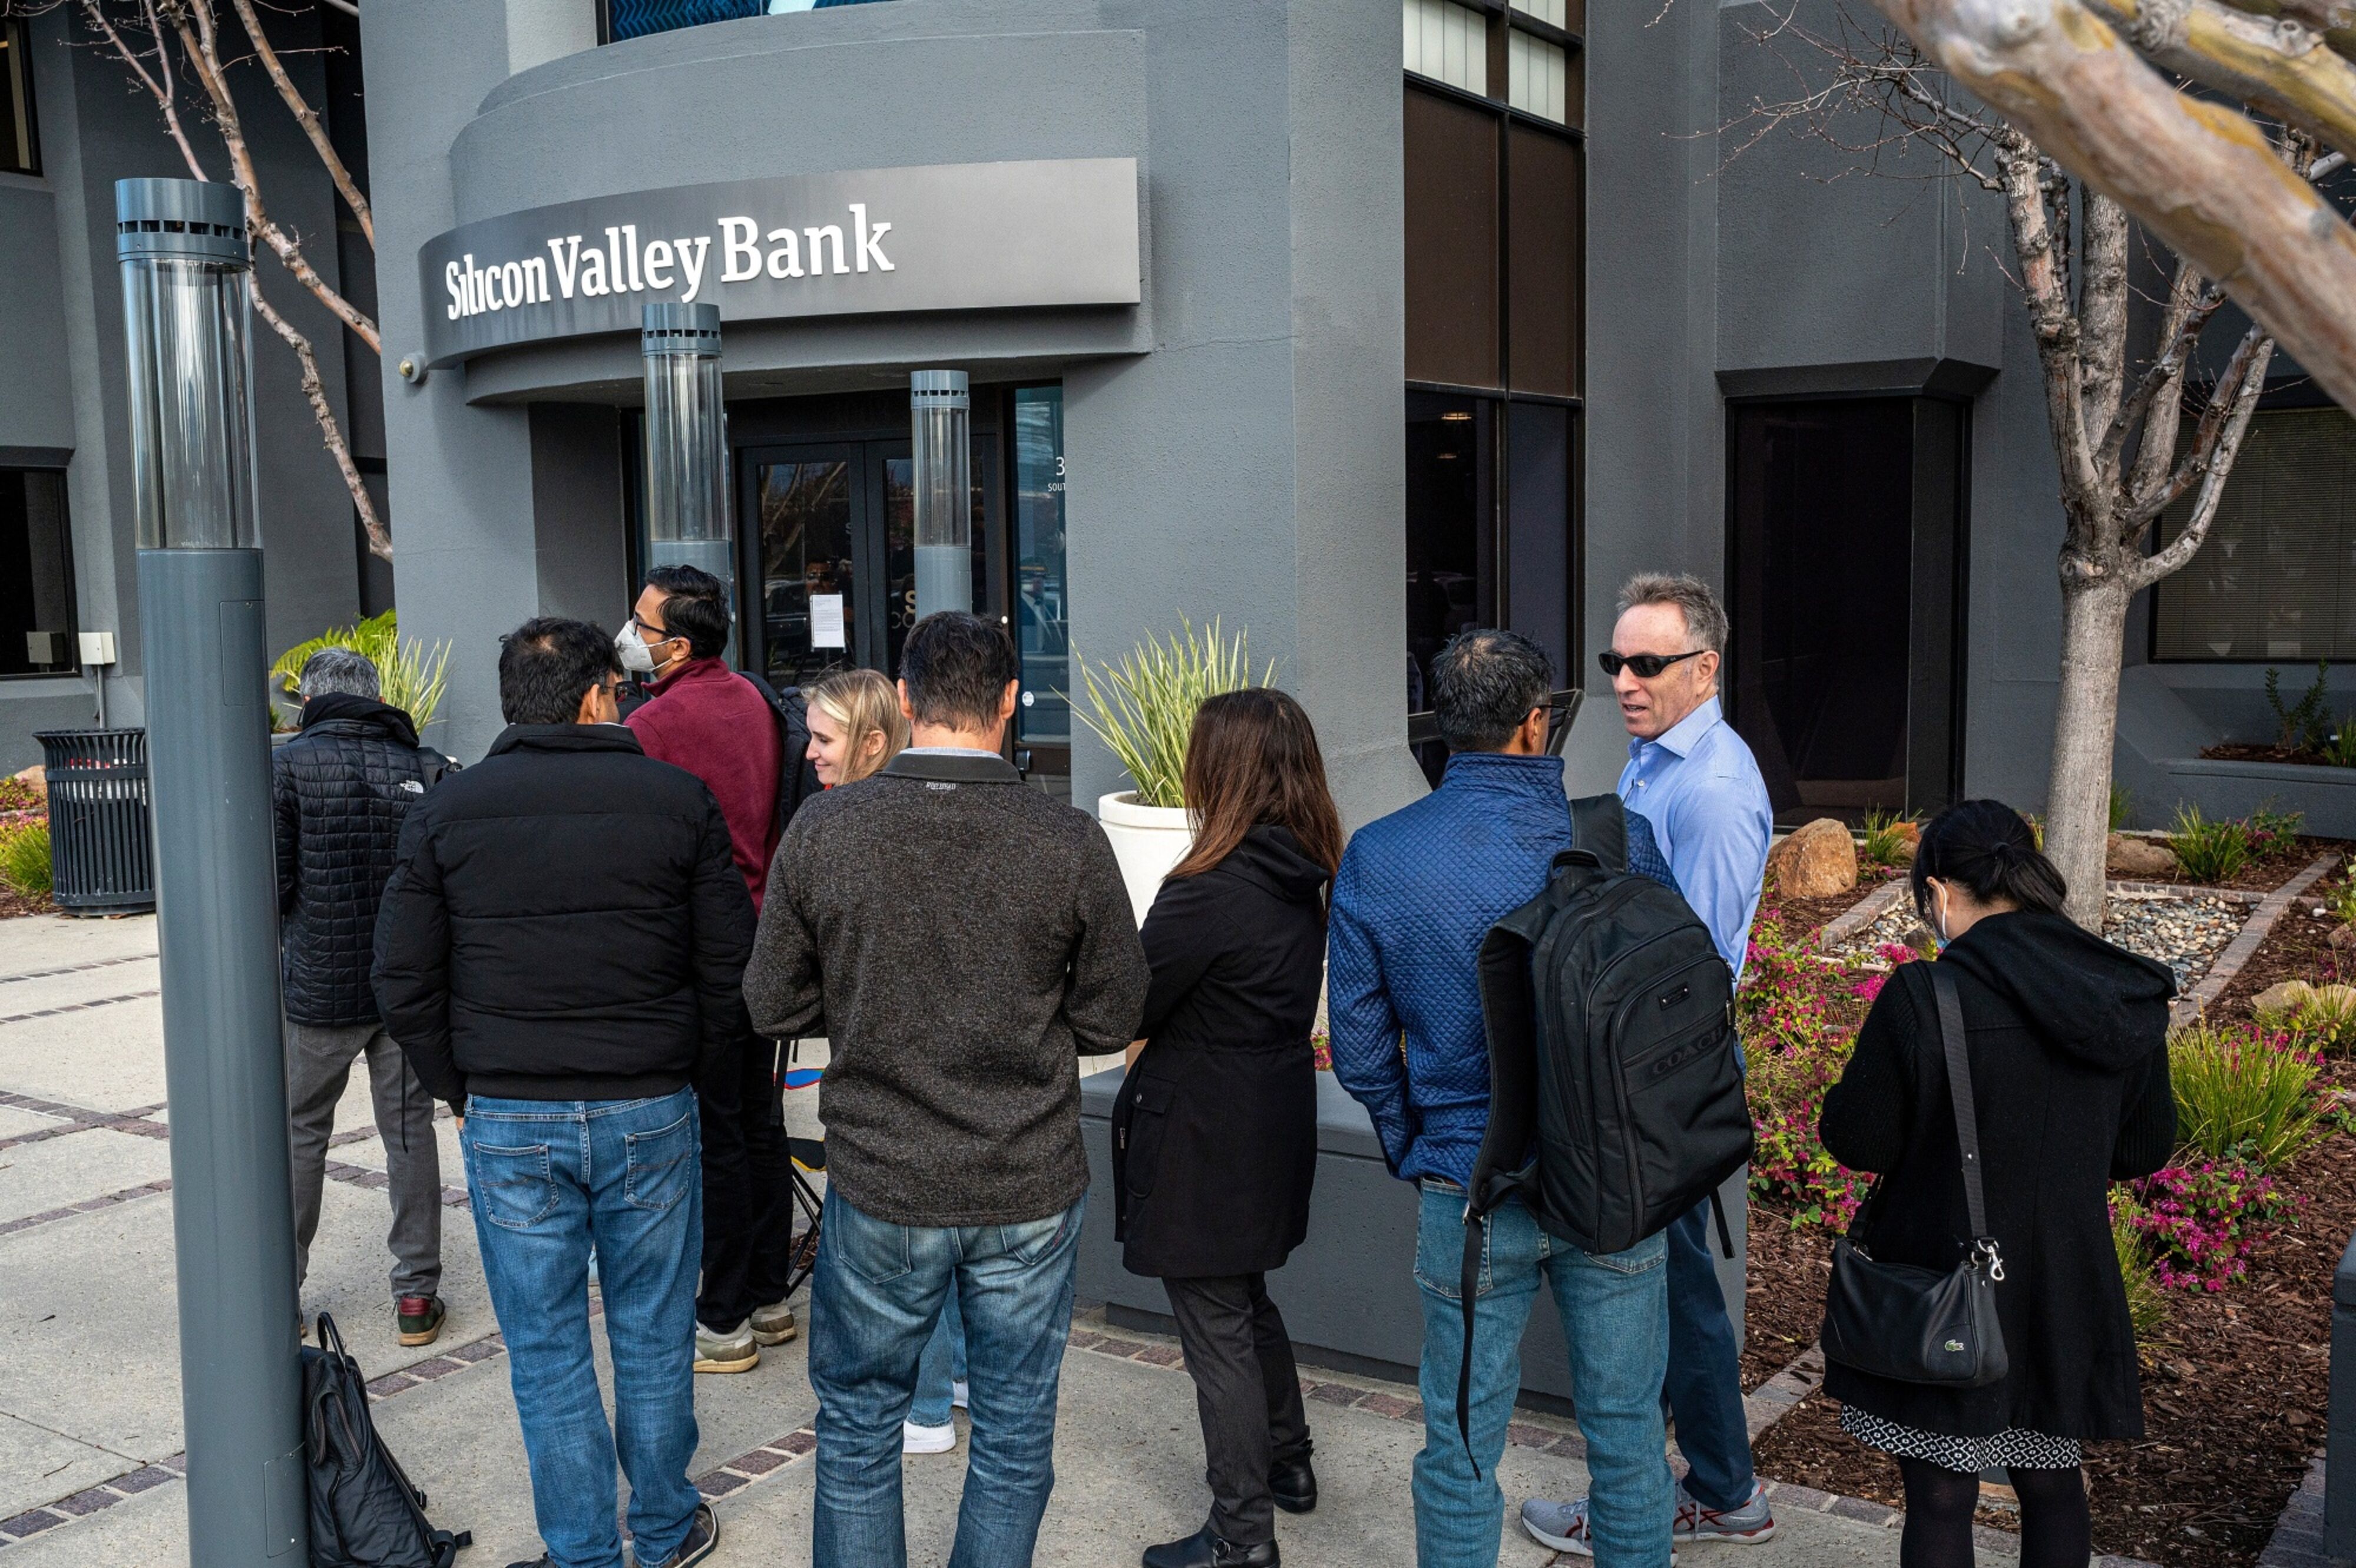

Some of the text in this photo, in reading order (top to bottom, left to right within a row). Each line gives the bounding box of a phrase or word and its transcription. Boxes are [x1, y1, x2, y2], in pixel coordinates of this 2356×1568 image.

[446, 203, 896, 321] Silicon Valley Bank
[1653, 1027, 1722, 1074] COACH
